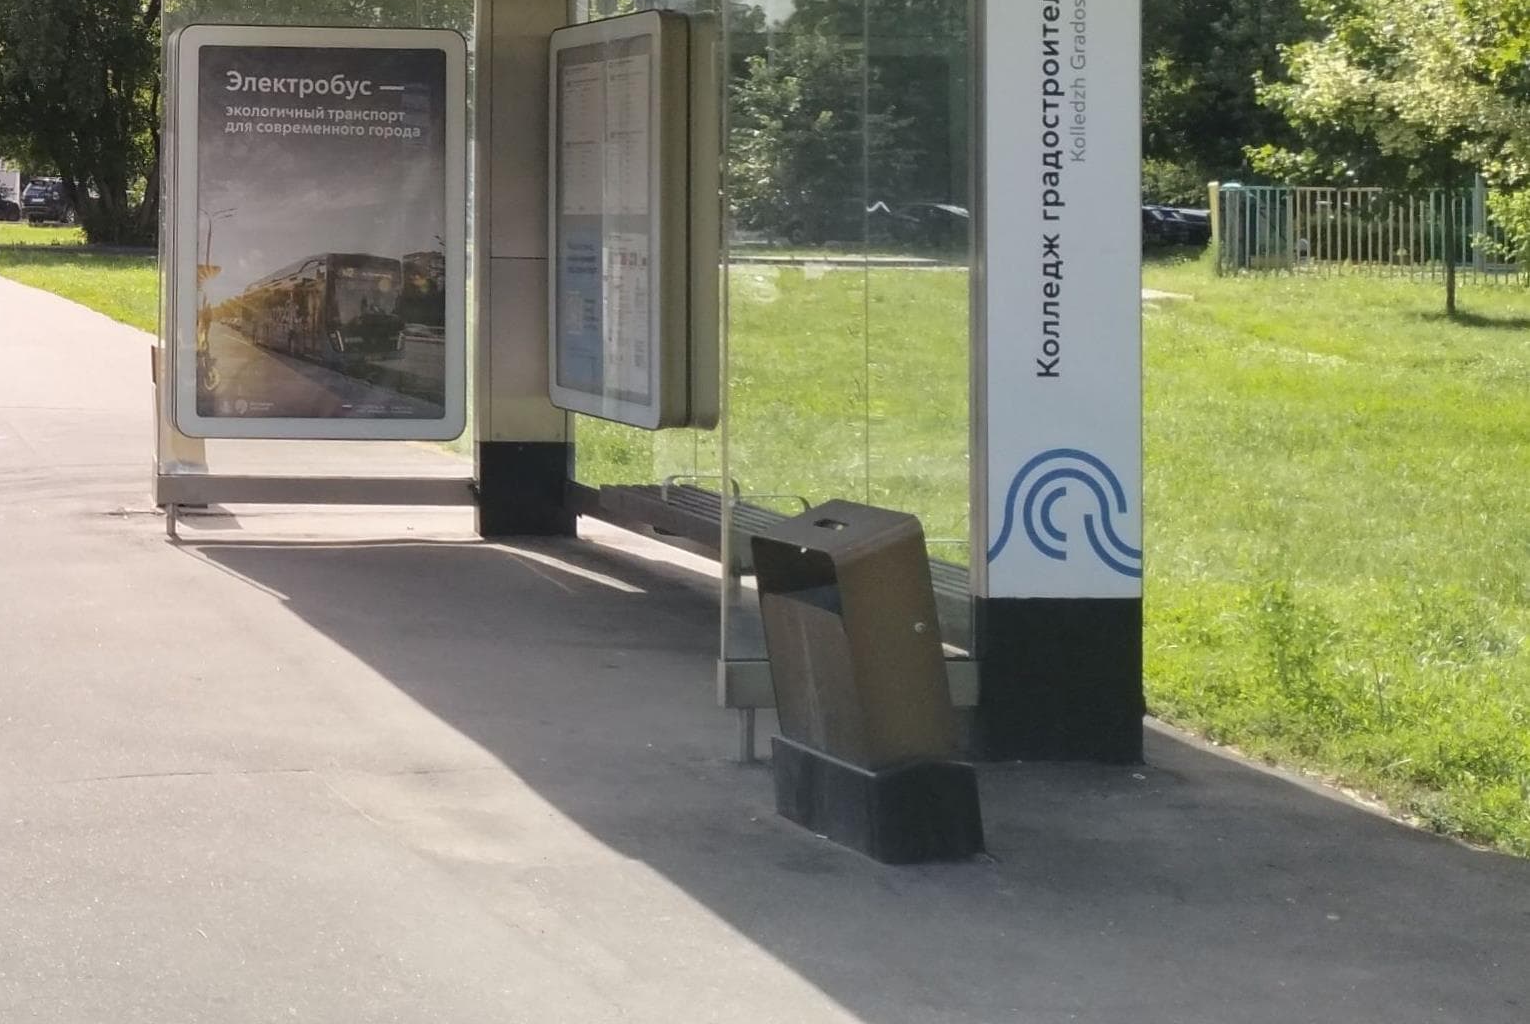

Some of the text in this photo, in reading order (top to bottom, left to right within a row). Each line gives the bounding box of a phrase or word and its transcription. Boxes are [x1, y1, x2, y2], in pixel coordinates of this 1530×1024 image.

[226, 70, 372, 100] Электробус
[226, 105, 406, 123] экологичный транспорт
[1070, 77, 1086, 163] Kolledzh
[225, 121, 421, 139] для современного города
[1036, 233, 1063, 377] Колледж
